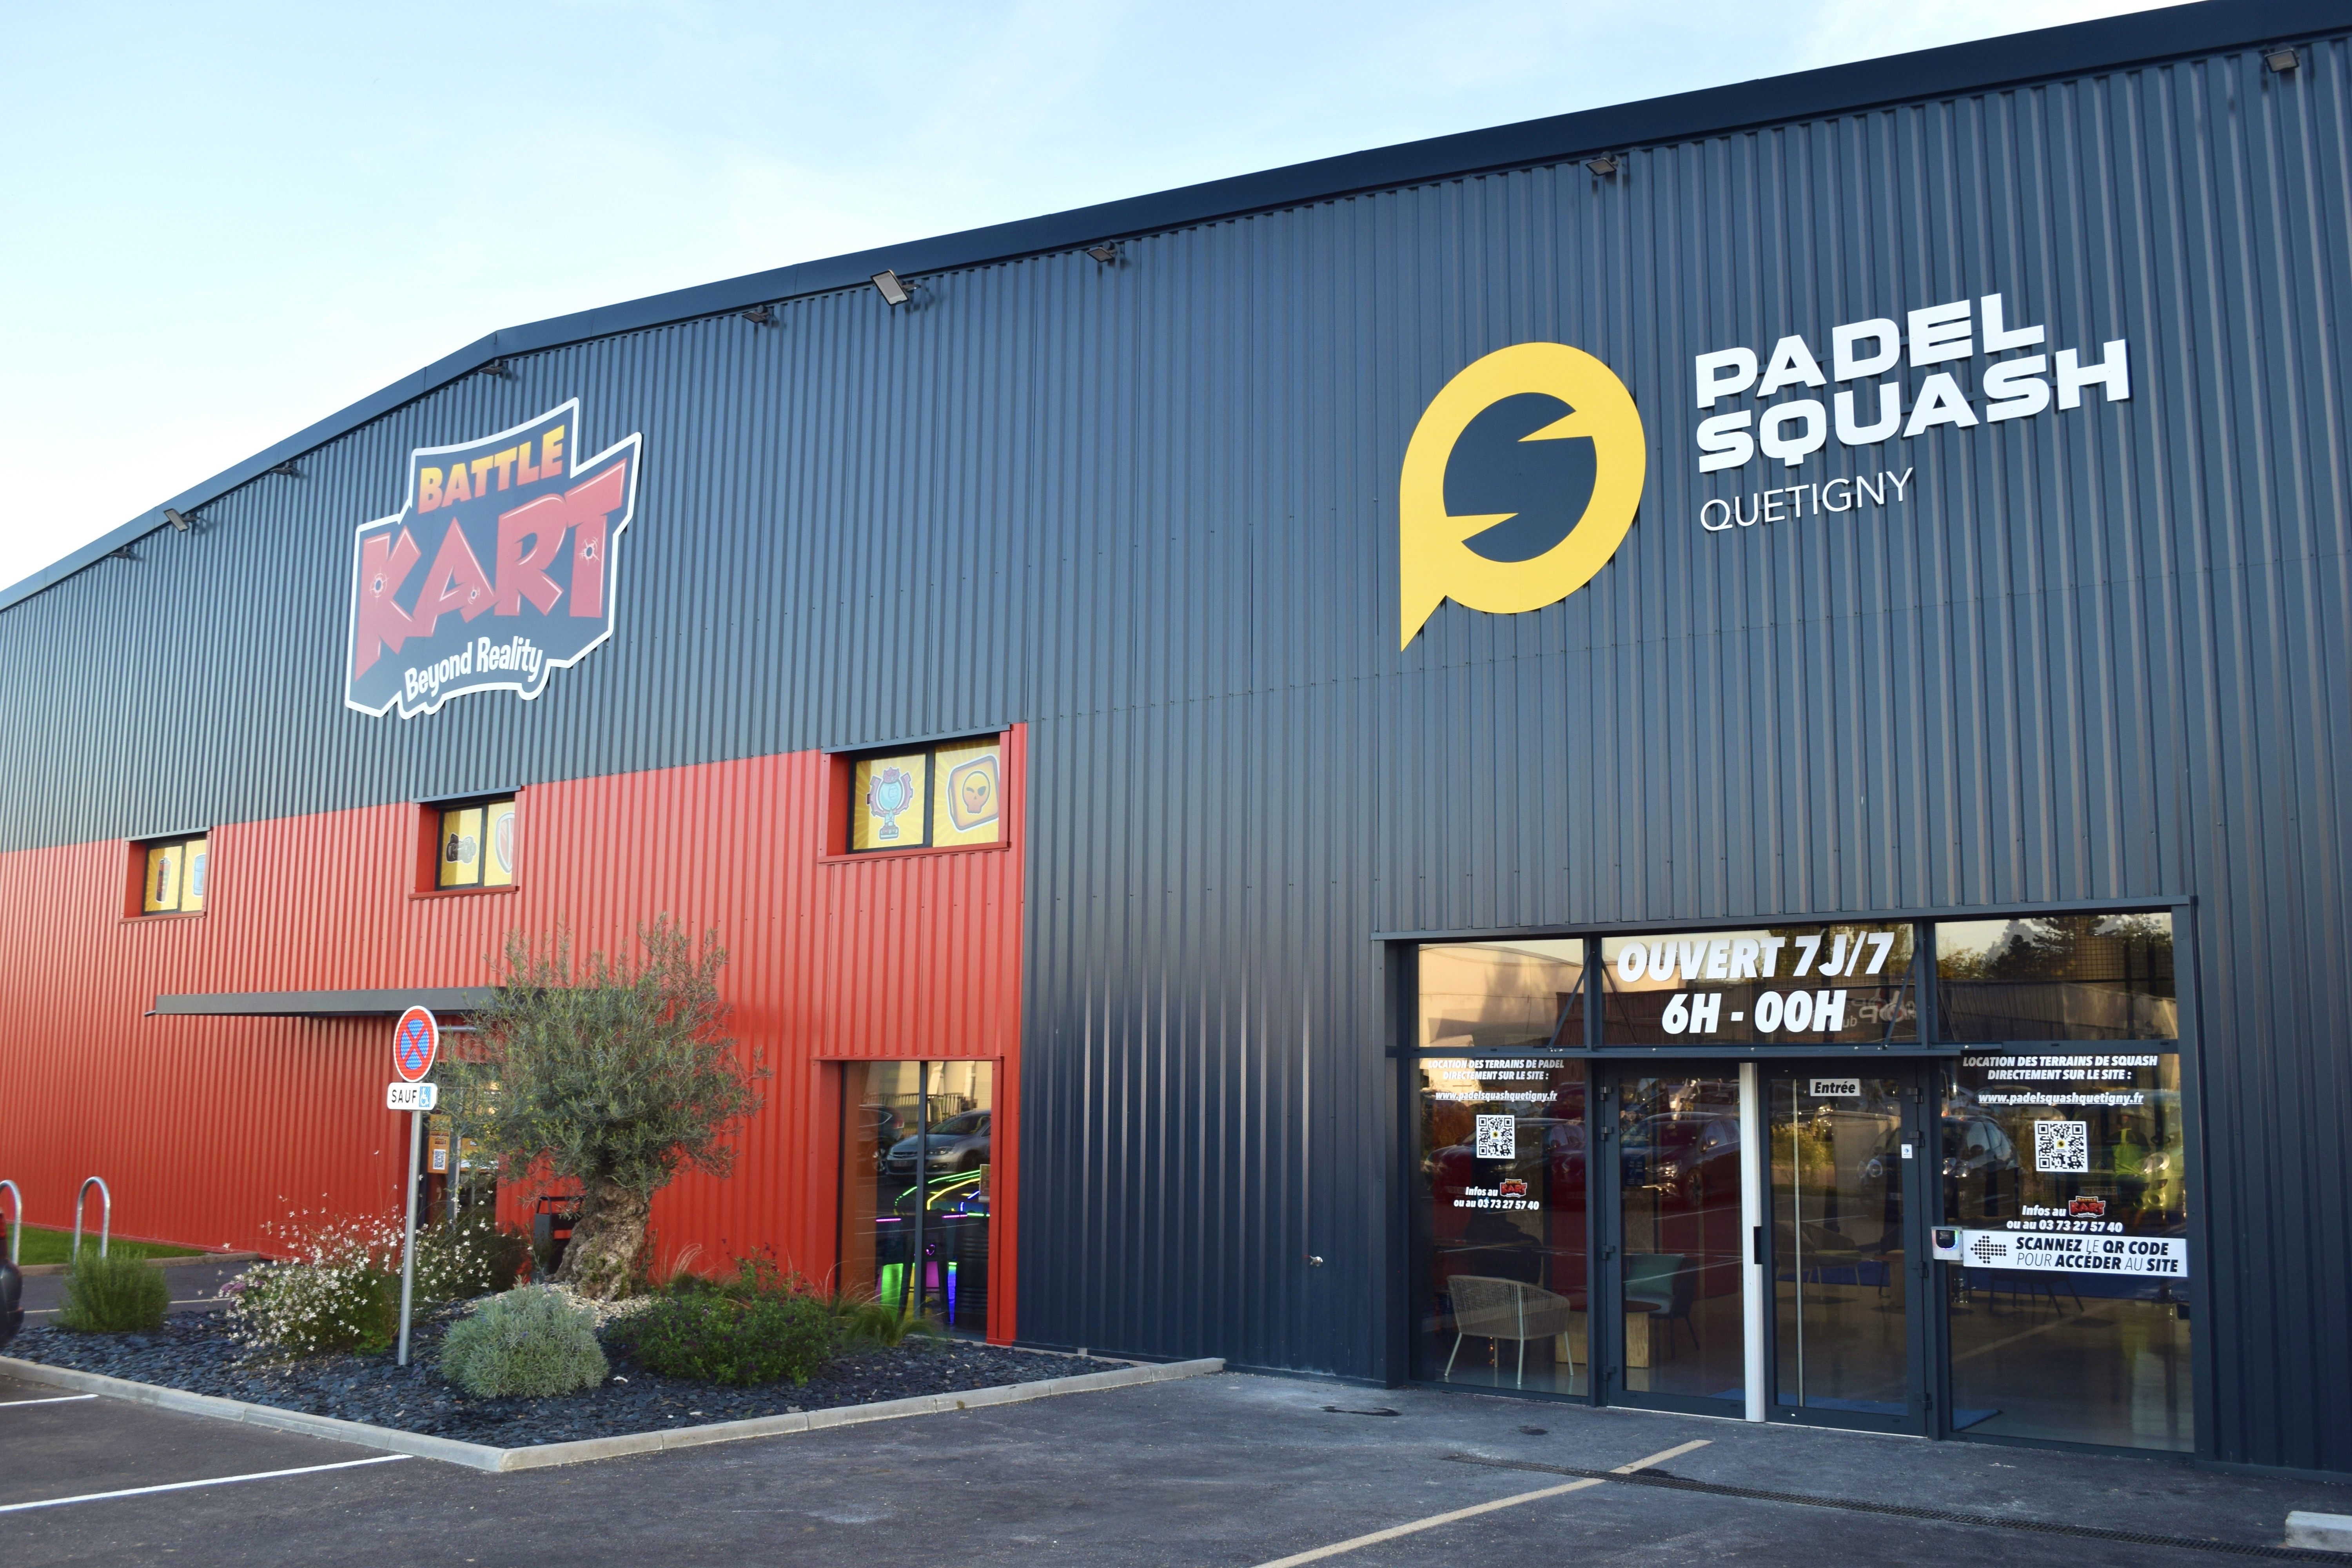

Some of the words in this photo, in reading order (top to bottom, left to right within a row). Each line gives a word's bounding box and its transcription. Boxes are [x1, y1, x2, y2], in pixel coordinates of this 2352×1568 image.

[1696, 293, 2045, 408] PADEL
[1696, 339, 2130, 473] SQUASH
[418, 425, 564, 514] BATTLE
[1700, 468, 1914, 531] QUETIGNY
[355, 457, 627, 682] KART
[404, 642, 472, 702] Beyond
[476, 635, 543, 682] Reality
[1618, 936, 1786, 982] OUVERT
[1662, 993, 1722, 1035] 6H
[1731, 1011, 1744, 1021] -
[1428, 1060, 1467, 1069] LOCATION
[1469, 1060, 1484, 1068] DES
[1485, 1060, 1524, 1069] TERRAINS
[1526, 1060, 1537, 1068] DE
[1538, 1060, 1564, 1068] PADEL
[1963, 1056, 2016, 1067] LOCATION
[2017, 1056, 2038, 1066] DES
[2040, 1056, 2093, 1066] TERRAINS
[2095, 1056, 2111, 1066] DE
[2111, 1055, 2158, 1066] SQUASH
[1443, 1071, 1498, 1080] DIRECTEMENT
[1498, 1071, 1515, 1080] SUR
[1516, 1071, 1526, 1080] LE
[1526, 1071, 1544, 1080] SITE
[1987, 1069, 2062, 1080] DIRECTEMENT
[2062, 1069, 2085, 1080] SUR
[2087, 1069, 2100, 1079] LE
[2101, 1069, 2125, 1079] SITE
[1814, 1081, 1856, 1094] Entrée
[391, 1089, 417, 1103] SAUF
[1435, 1090, 1558, 1102] www.padelsquashquetigny.fr
[1978, 1092, 2144, 1106] www.padelsquashquetigny.fr
[1465, 1186, 1486, 1196] Infos
[1477, 1199, 1489, 1208] 03
[1490, 1200, 1501, 1209] 73
[1503, 1200, 1514, 1209] 27
[1515, 1200, 1526, 1209] 57
[1527, 1201, 1539, 1210] 40
[2022, 1205, 2050, 1216] Infos
[2052, 1208, 2067, 1216] au
[2070, 1201, 2105, 1214] KART
[2006, 1221, 2022, 1229] ou
[2023, 1221, 2036, 1230] au
[2039, 1220, 2053, 1230] 03
[2056, 1220, 2071, 1231] 73
[2073, 1221, 2088, 1231] 27
[2089, 1221, 2105, 1232] 57
[2107, 1222, 2123, 1233] 40
[2016, 1236, 2082, 1252] SCANNEZ
[2086, 1239, 2100, 1253] LE
[2103, 1240, 2123, 1254] QR
[2128, 1241, 2169, 1256] CODE
[2017, 1252, 2052, 1267] POUR
[2124, 1257, 2143, 1271] AU
[2146, 1258, 2178, 1272] SITE
